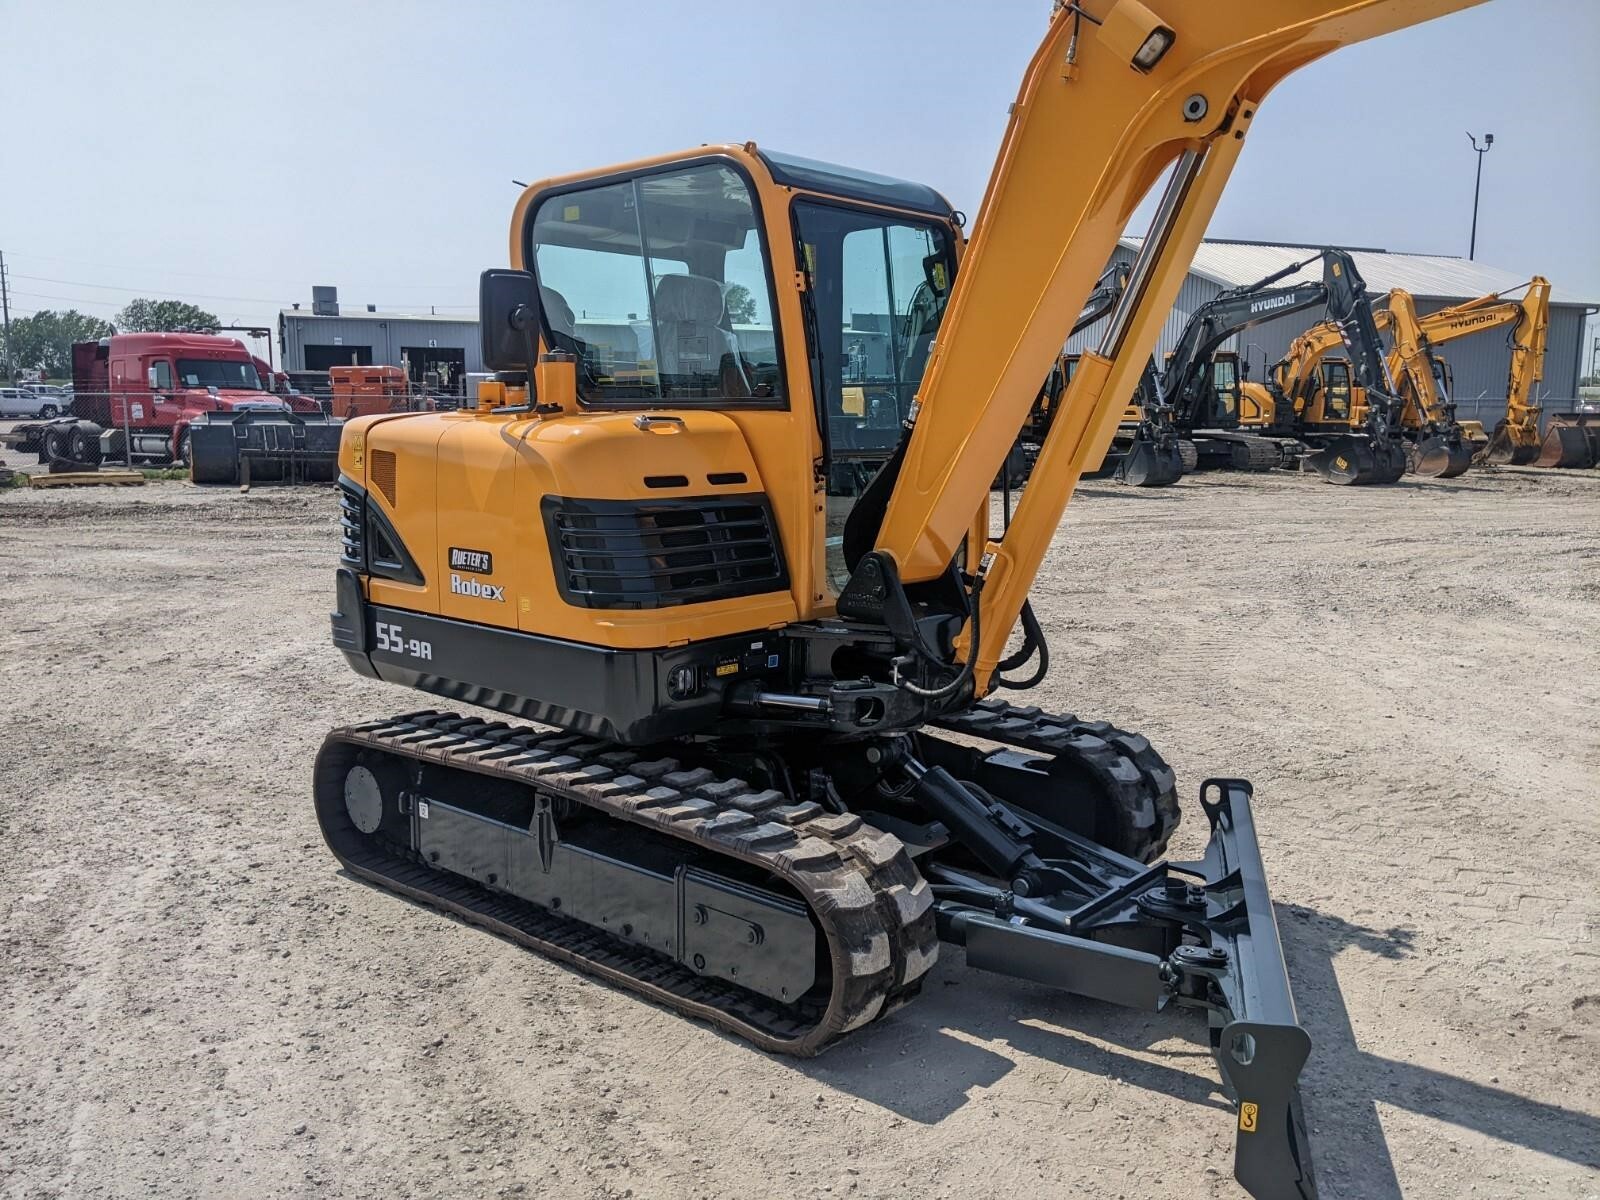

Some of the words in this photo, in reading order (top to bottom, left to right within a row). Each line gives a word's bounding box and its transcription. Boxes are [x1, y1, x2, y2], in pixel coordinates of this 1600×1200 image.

[1251, 293, 1295, 313] HYUNDAI
[1450, 313, 1496, 330] HYUNDAI
[452, 548, 489, 570] RUETER'S
[451, 573, 505, 602] Robex
[376, 622, 432, 660] 55-9A
